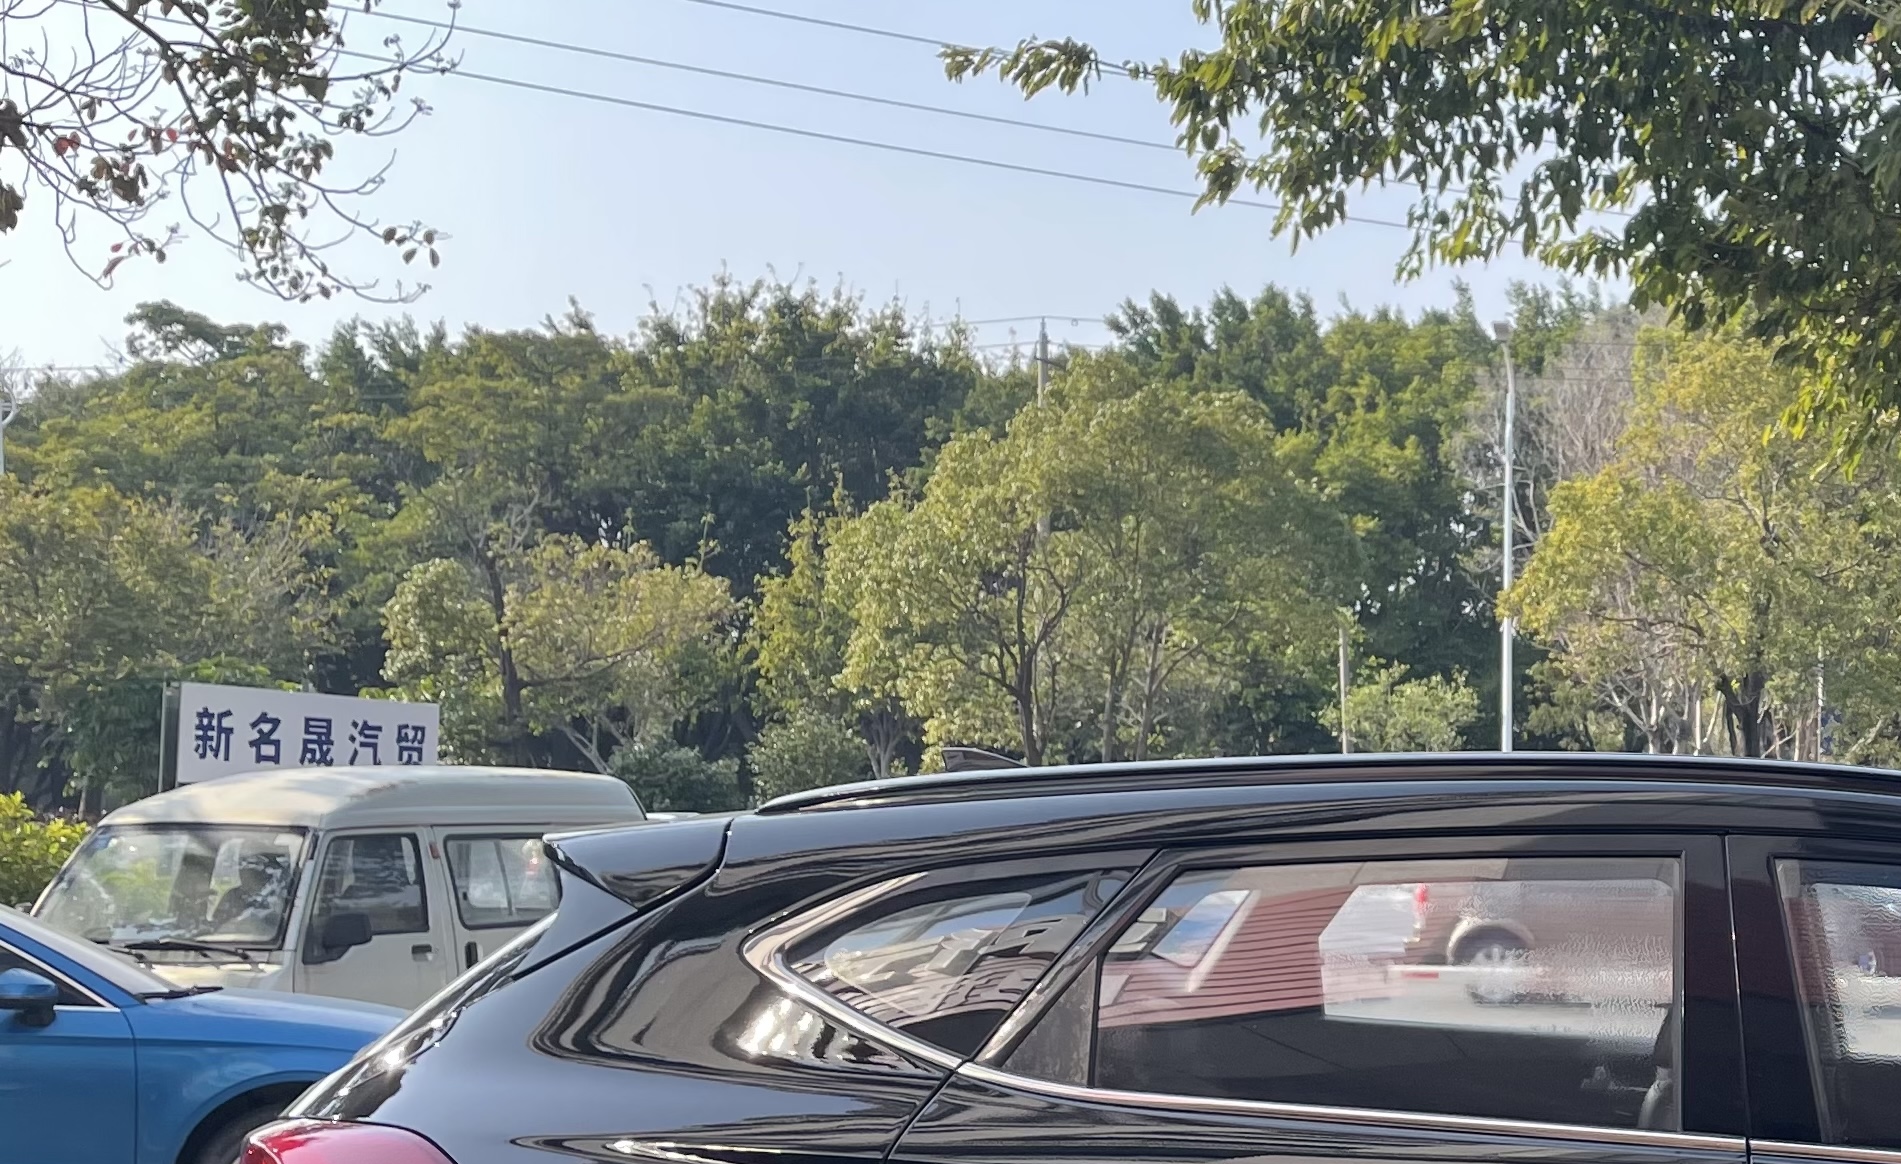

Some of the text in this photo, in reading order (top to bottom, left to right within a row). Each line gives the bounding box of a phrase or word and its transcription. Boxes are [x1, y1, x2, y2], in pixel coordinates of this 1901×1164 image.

[194, 706, 427, 766] 新名晟汽贸
